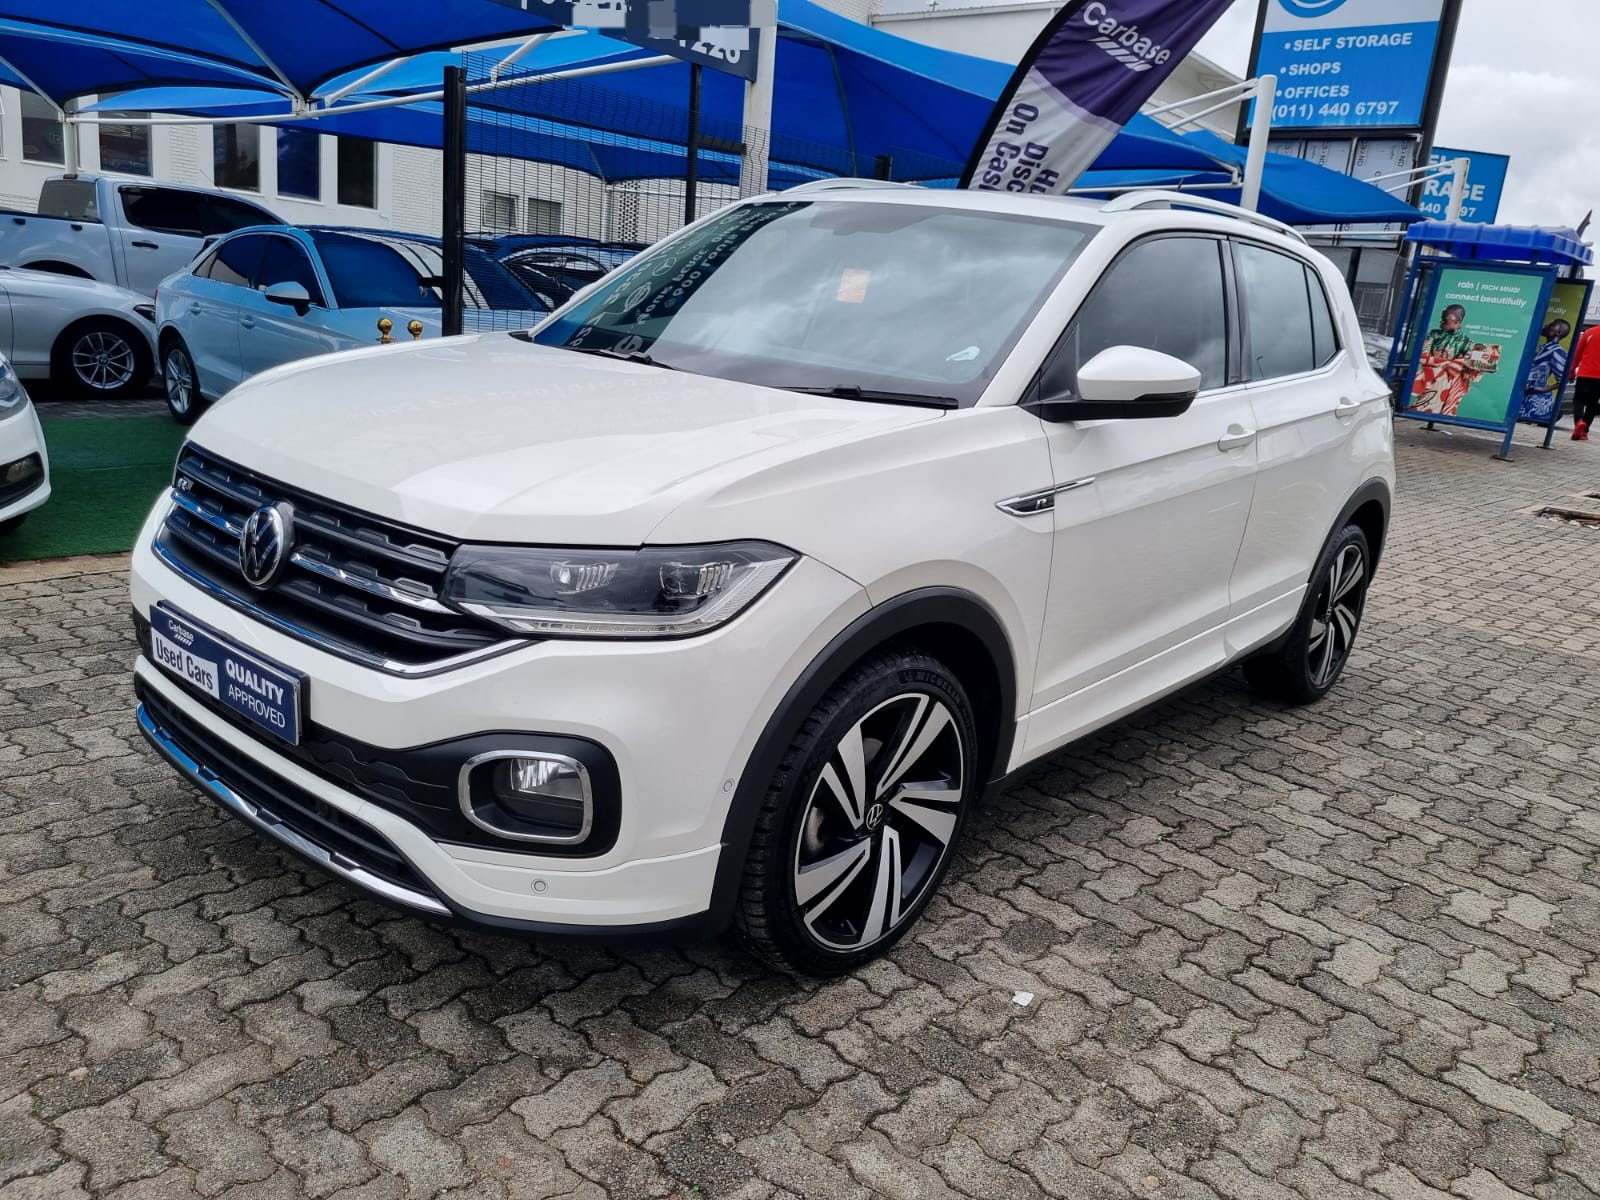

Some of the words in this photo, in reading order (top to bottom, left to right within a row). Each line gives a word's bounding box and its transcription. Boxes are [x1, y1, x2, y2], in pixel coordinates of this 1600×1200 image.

[1083, 2, 1171, 65] Carbase
[1293, 38, 1332, 52] SELF
[1335, 32, 1413, 49] STORAGE
[1288, 61, 1342, 76] SHOPS
[1284, 84, 1350, 100] OFFICES
[1006, 102, 1039, 136] On
[1272, 104, 1314, 121] (011)
[1318, 102, 1350, 117] 440
[1355, 101, 1399, 116] 6797
[1445, 292, 1479, 302] connect
[1480, 294, 1527, 308] beautifully
[168, 619, 194, 642] Carbase
[155, 637, 183, 671] Used
[186, 655, 213, 691] Cars
[225, 658, 284, 705] QUALITY
[228, 684, 286, 728] APPROVED
